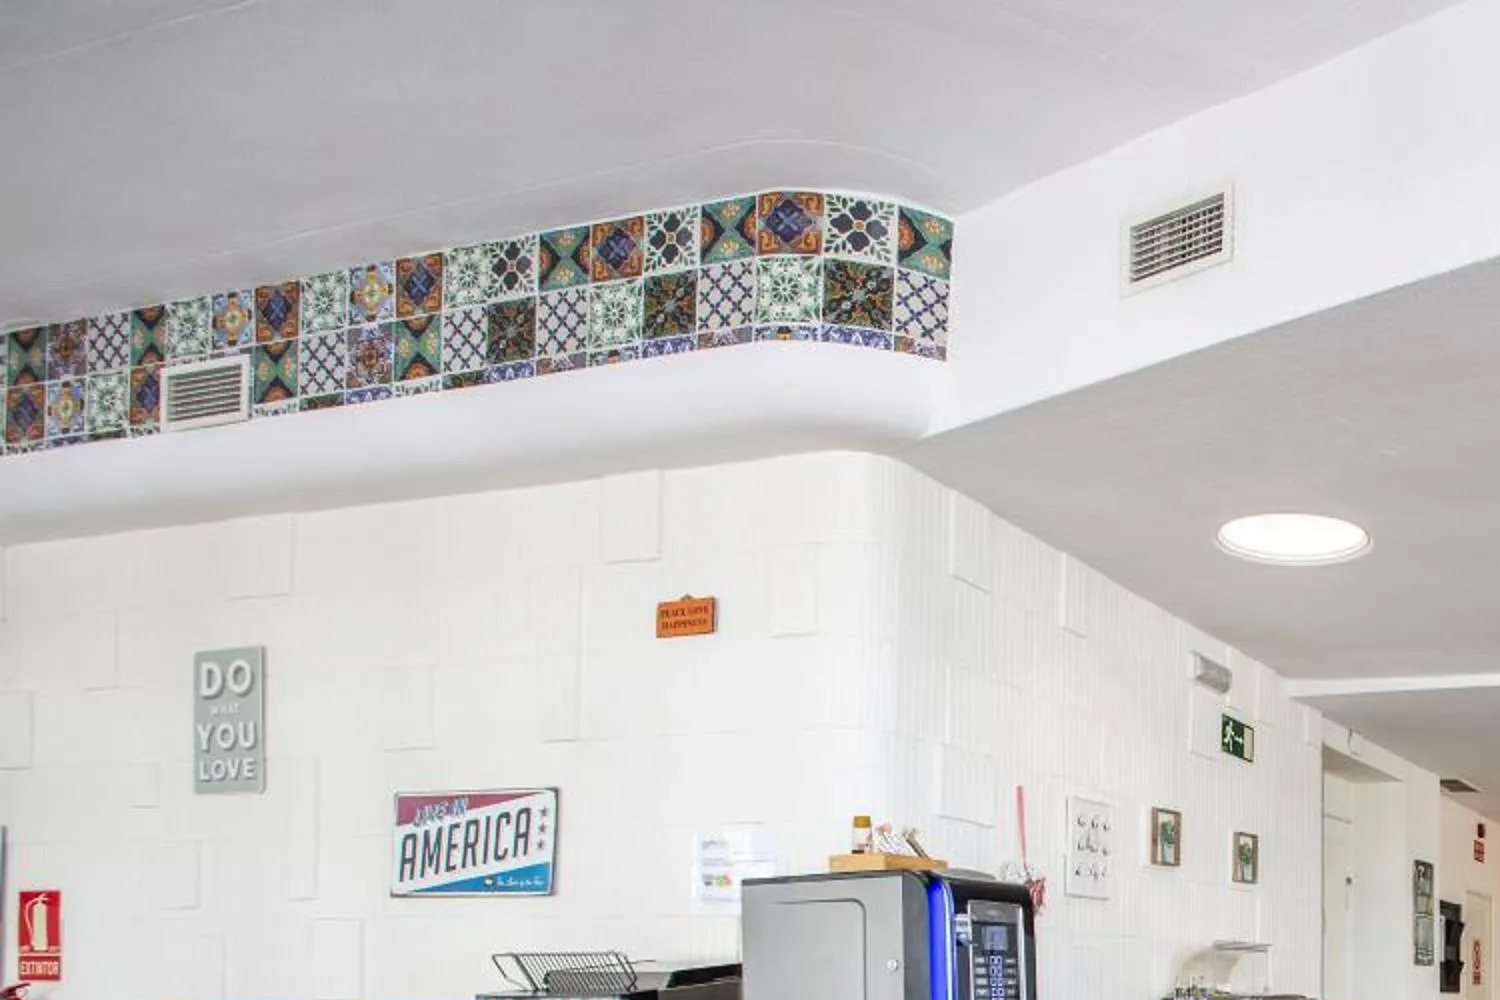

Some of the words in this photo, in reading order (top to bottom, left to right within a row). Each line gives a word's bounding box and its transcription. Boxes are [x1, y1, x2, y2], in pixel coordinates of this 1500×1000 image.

[201, 659, 251, 697] DO
[197, 721, 255, 752] YOU
[200, 757, 255, 781] LOVE
[400, 807, 531, 882] AMERICA
